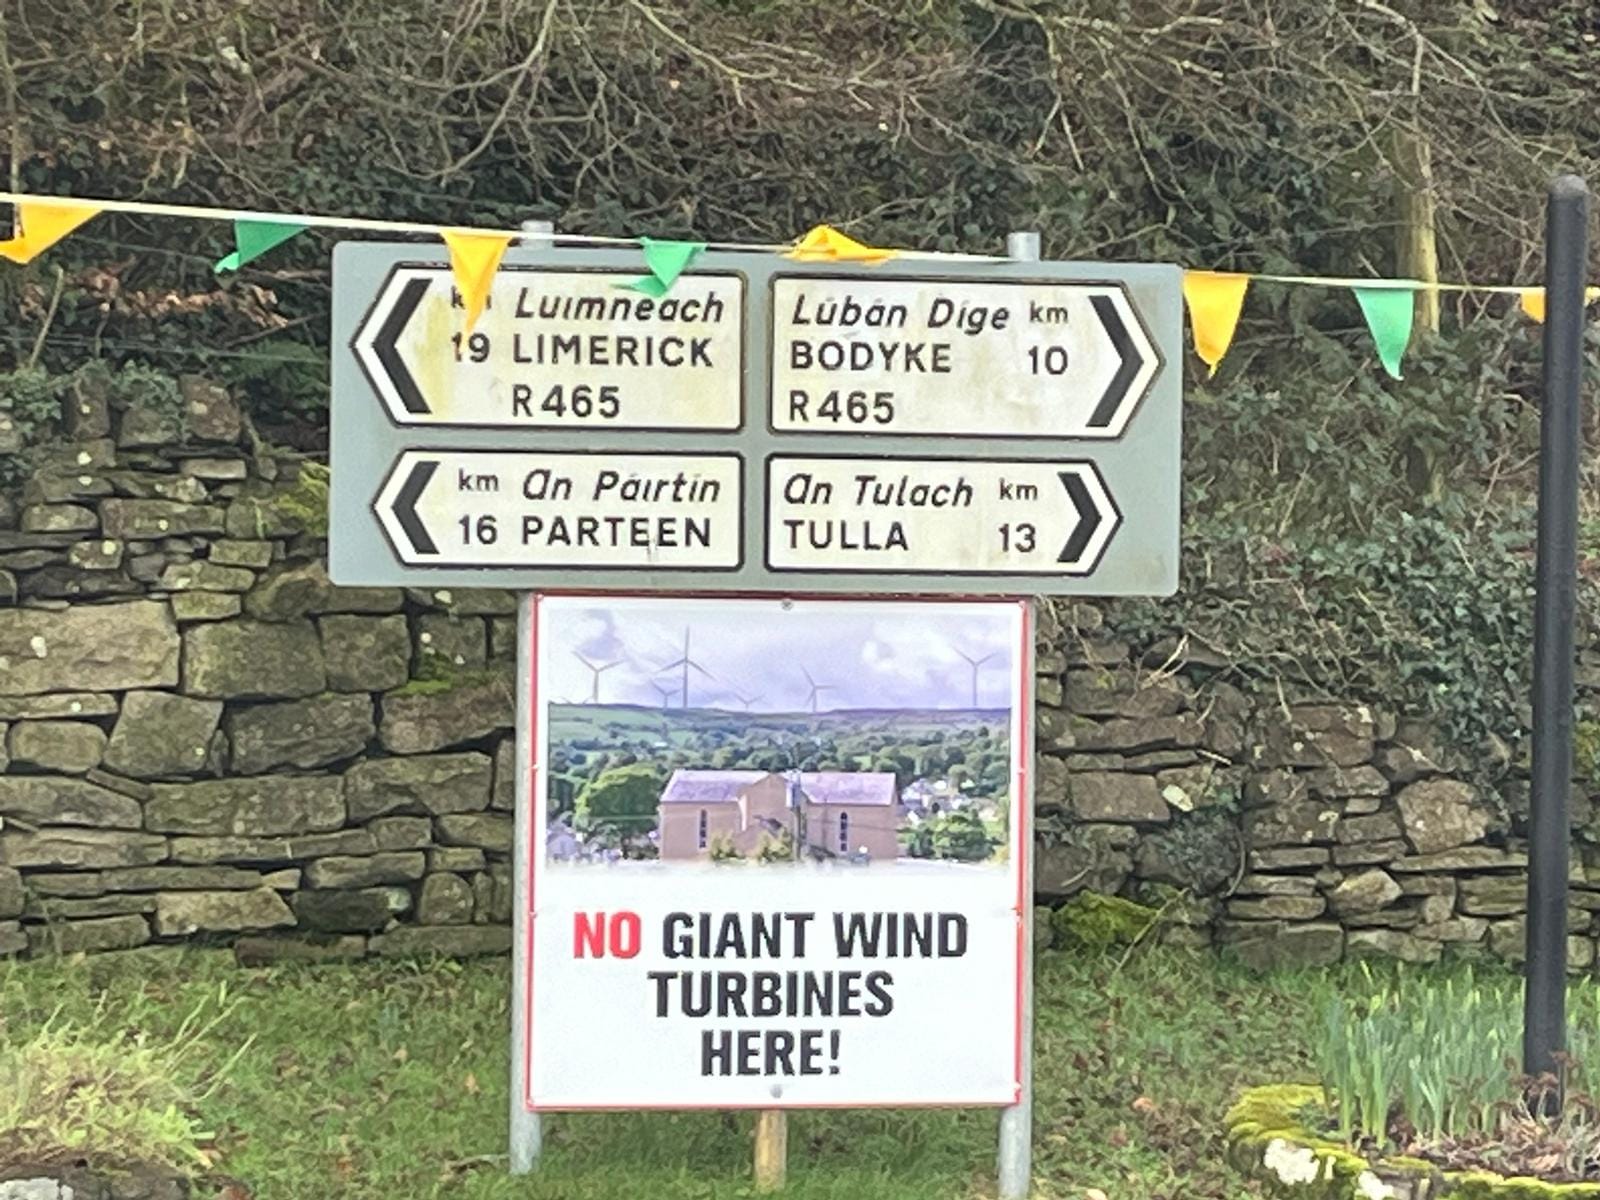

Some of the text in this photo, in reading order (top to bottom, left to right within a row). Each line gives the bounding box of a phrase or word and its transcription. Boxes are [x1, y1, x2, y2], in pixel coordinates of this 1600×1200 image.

[514, 286, 724, 323] Luimneach
[1029, 301, 1069, 324] km
[451, 332, 714, 368] 19 LIMERICK
[790, 340, 1068, 376] BODYKE 10
[458, 468, 499, 492] km
[522, 468, 573, 502] An
[783, 473, 1038, 508] An Tulach km
[458, 514, 711, 548] 16 PARTEEN
[783, 519, 1036, 553] TULLA 13
[573, 911, 969, 960] NO GIANT WIND
[647, 970, 894, 1018] TURBINES
[700, 1029, 841, 1077] HERE!
